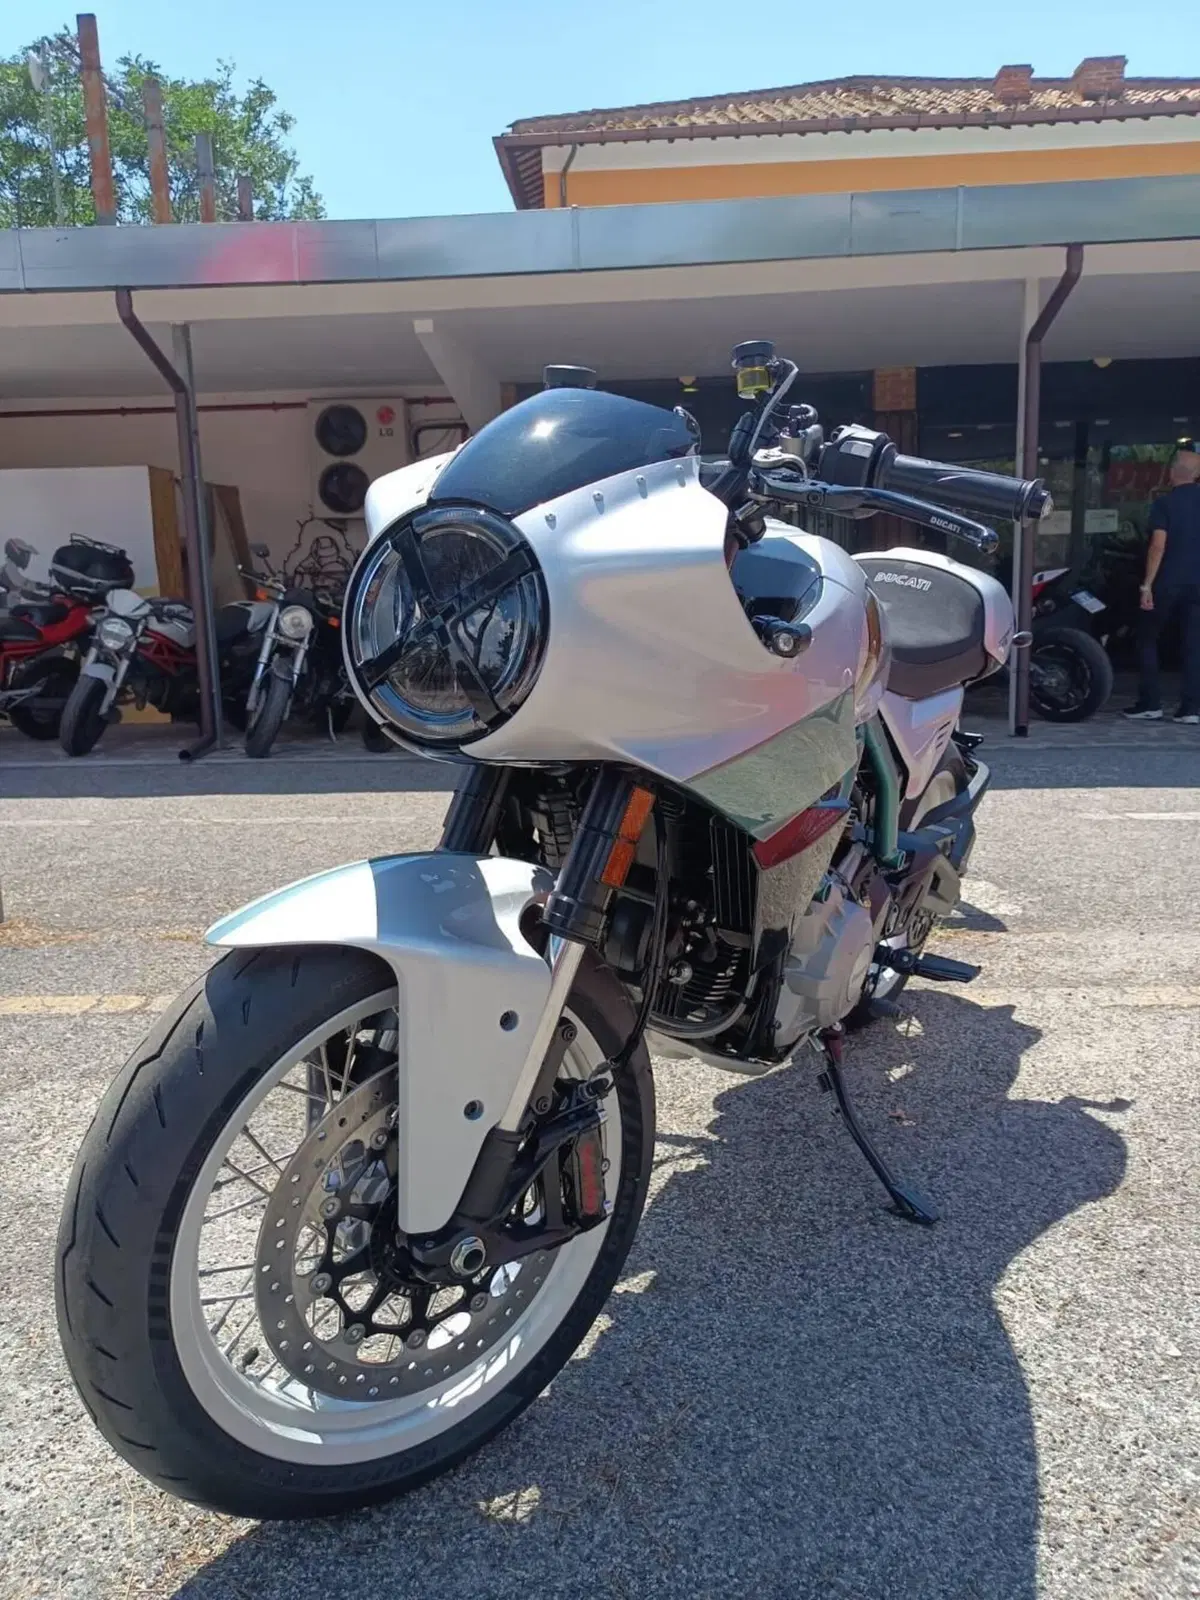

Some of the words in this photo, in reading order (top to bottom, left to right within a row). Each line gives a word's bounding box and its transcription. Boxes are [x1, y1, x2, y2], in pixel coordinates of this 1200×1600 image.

[379, 427, 394, 437] LG
[930, 516, 961, 533] DUCATI
[874, 571, 932, 591] DUCATI
